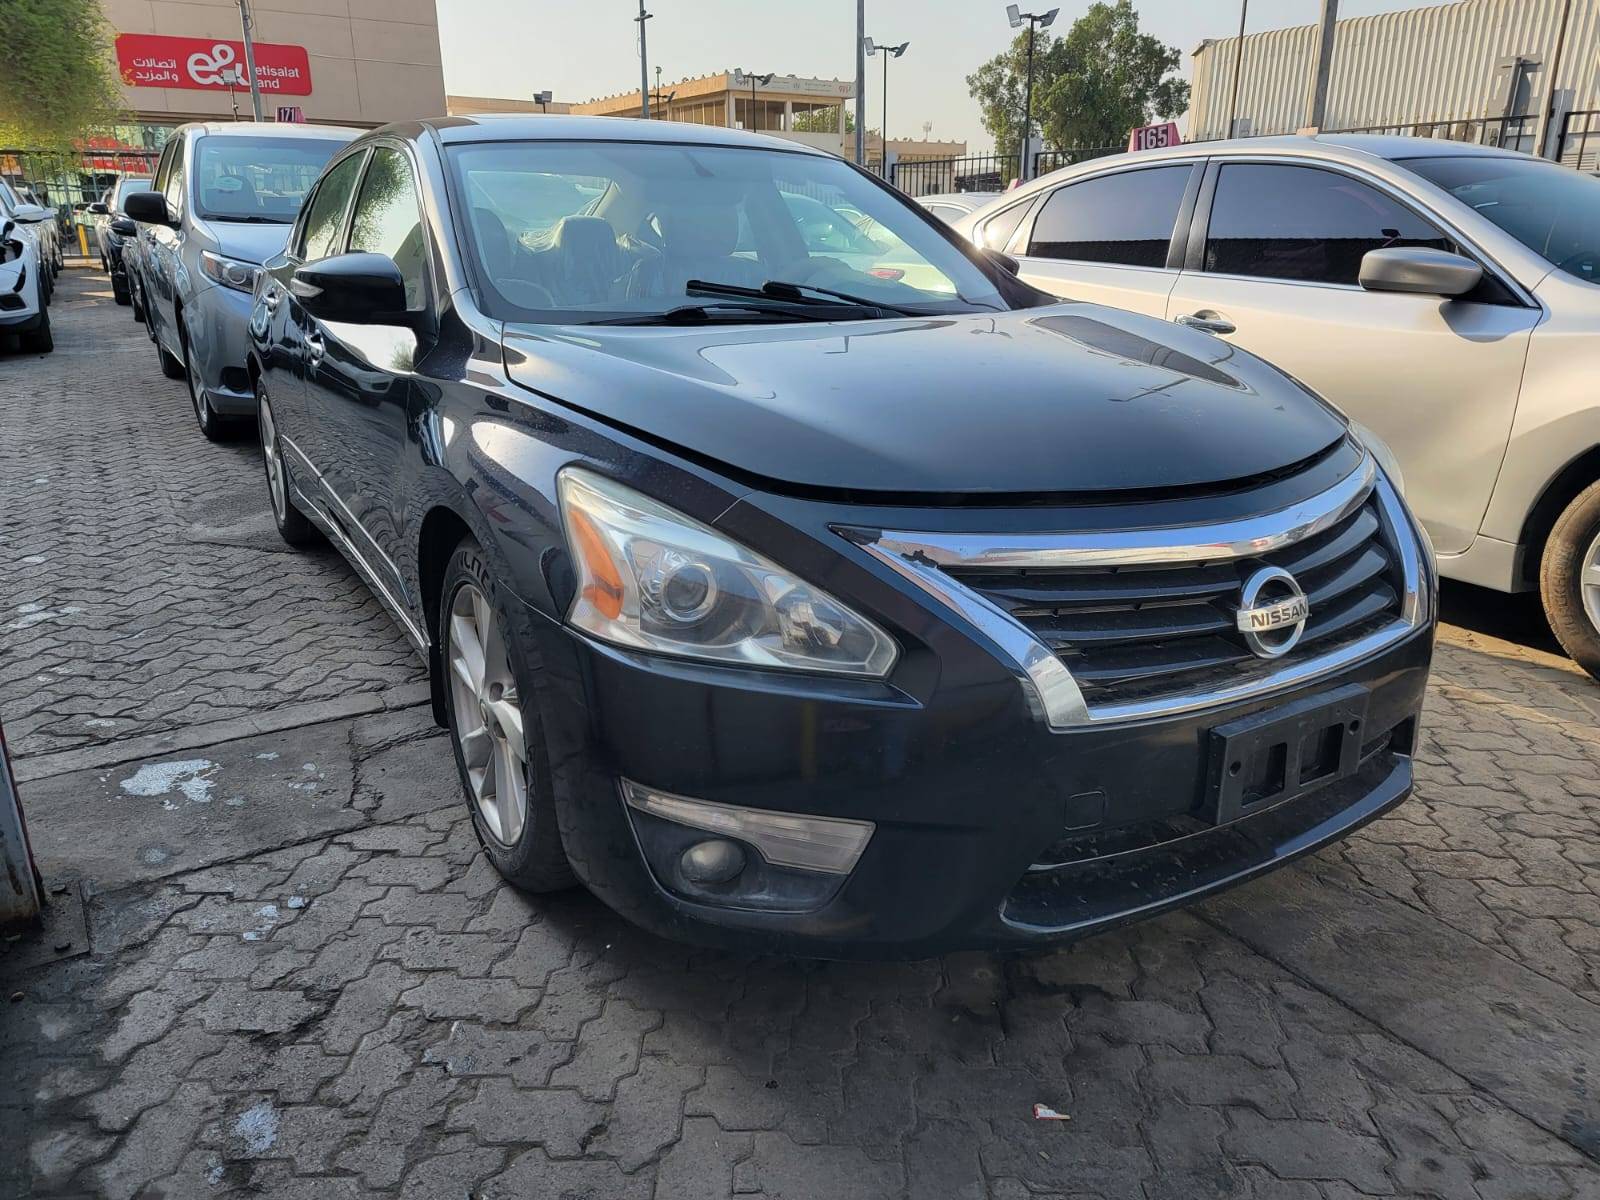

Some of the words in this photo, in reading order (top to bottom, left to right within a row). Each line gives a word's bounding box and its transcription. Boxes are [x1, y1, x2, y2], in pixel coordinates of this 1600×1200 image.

[133, 57, 177, 69] اتصالات
[255, 65, 299, 78] etisalat
[257, 79, 280, 89] and
[280, 107, 296, 122] 171
[1139, 125, 1168, 151] 165
[1250, 602, 1308, 628] NISSAN
